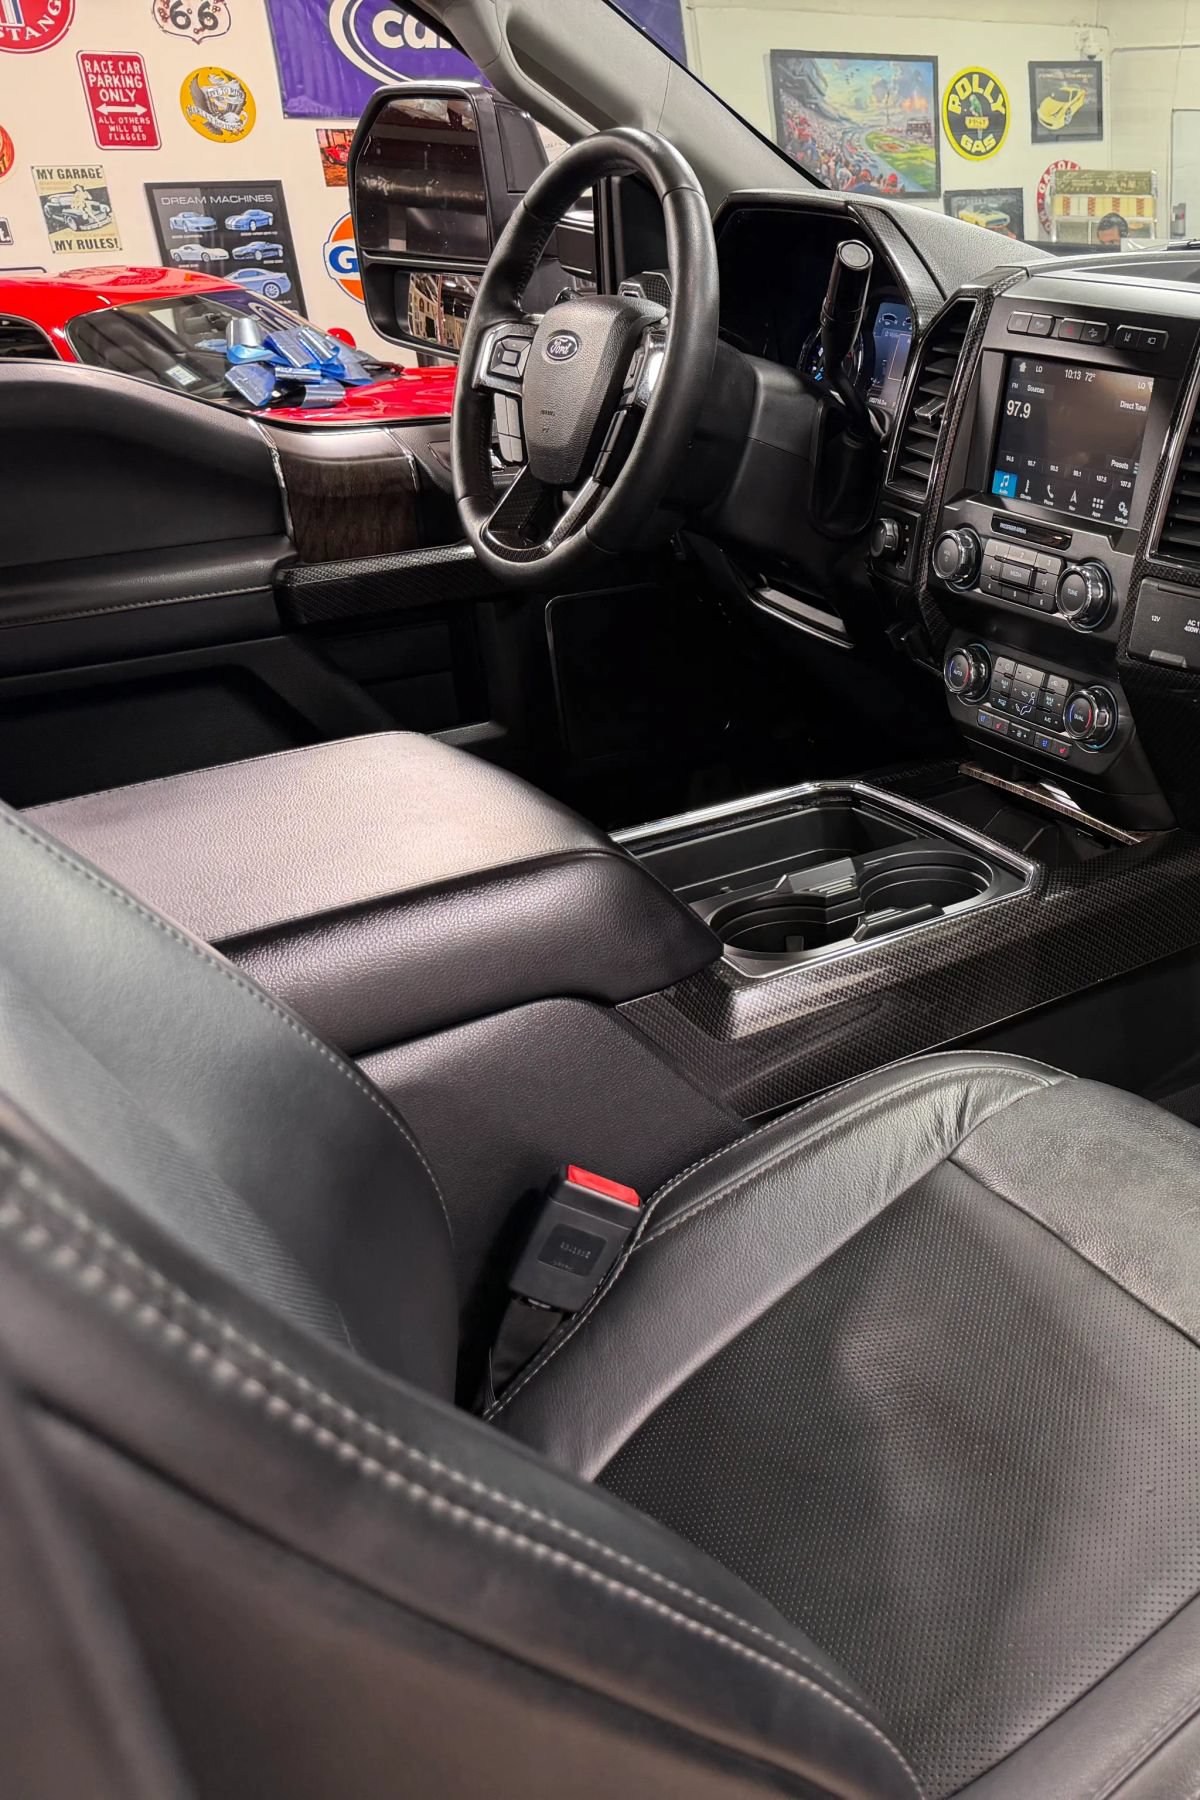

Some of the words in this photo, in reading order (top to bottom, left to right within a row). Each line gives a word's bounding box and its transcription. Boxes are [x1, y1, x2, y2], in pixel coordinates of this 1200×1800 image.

[170, 0, 219, 30] 66
[84, 60, 115, 74] RACE
[118, 61, 141, 74] CAR
[88, 74, 143, 88] PARKING
[99, 88, 136, 102] ONLY
[948, 74, 1005, 115] POLLY
[109, 133, 146, 141] FLAGGED
[961, 133, 996, 153] GAS
[36, 169, 54, 179] MY
[57, 168, 103, 179] GARAGE
[161, 196, 206, 205] DREAM
[210, 194, 273, 204] MACHINES
[55, 239, 76, 251] MY
[76, 238, 119, 250] RULES!
[550, 338, 572, 355] Ford
[1065, 369, 1081, 380] 10:13
[1006, 400, 1031, 418] 97.9
[1187, 619, 1196, 627] AC
